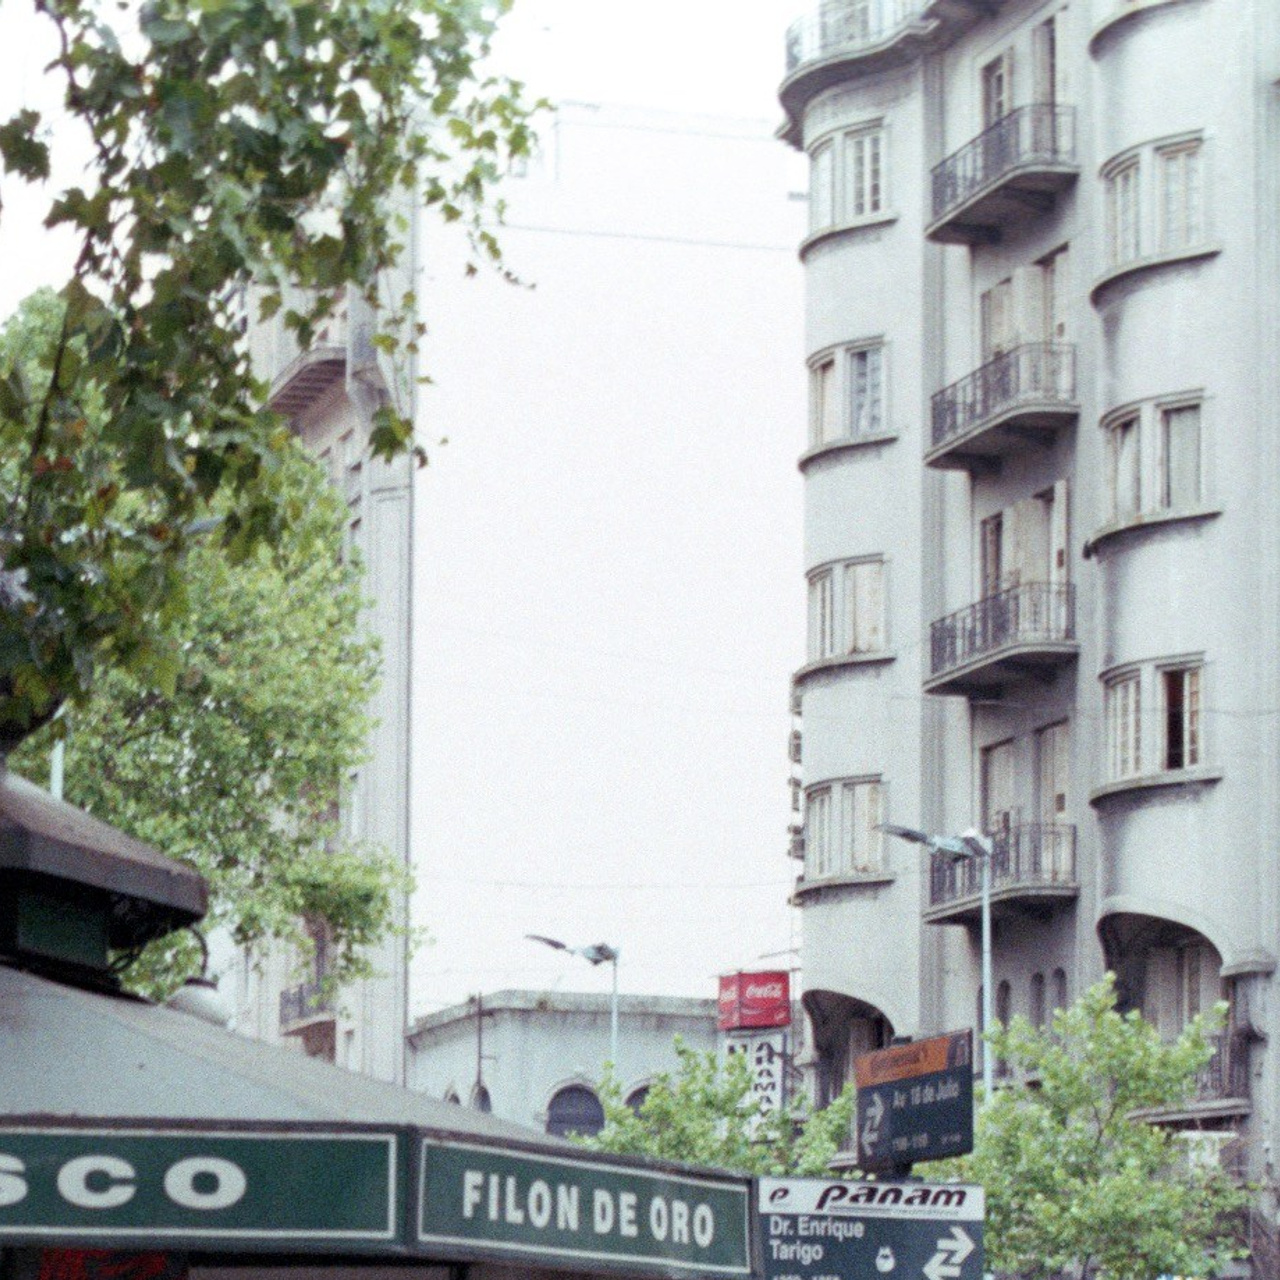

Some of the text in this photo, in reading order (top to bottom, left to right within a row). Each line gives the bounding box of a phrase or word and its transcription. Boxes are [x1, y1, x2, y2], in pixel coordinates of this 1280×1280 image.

[463, 1170, 714, 1248] FILON DE ORO
[815, 1185, 967, 1211] panam
[770, 1218, 865, 1242] Dr. Enrique
[770, 1240, 824, 1266] Tarigo
